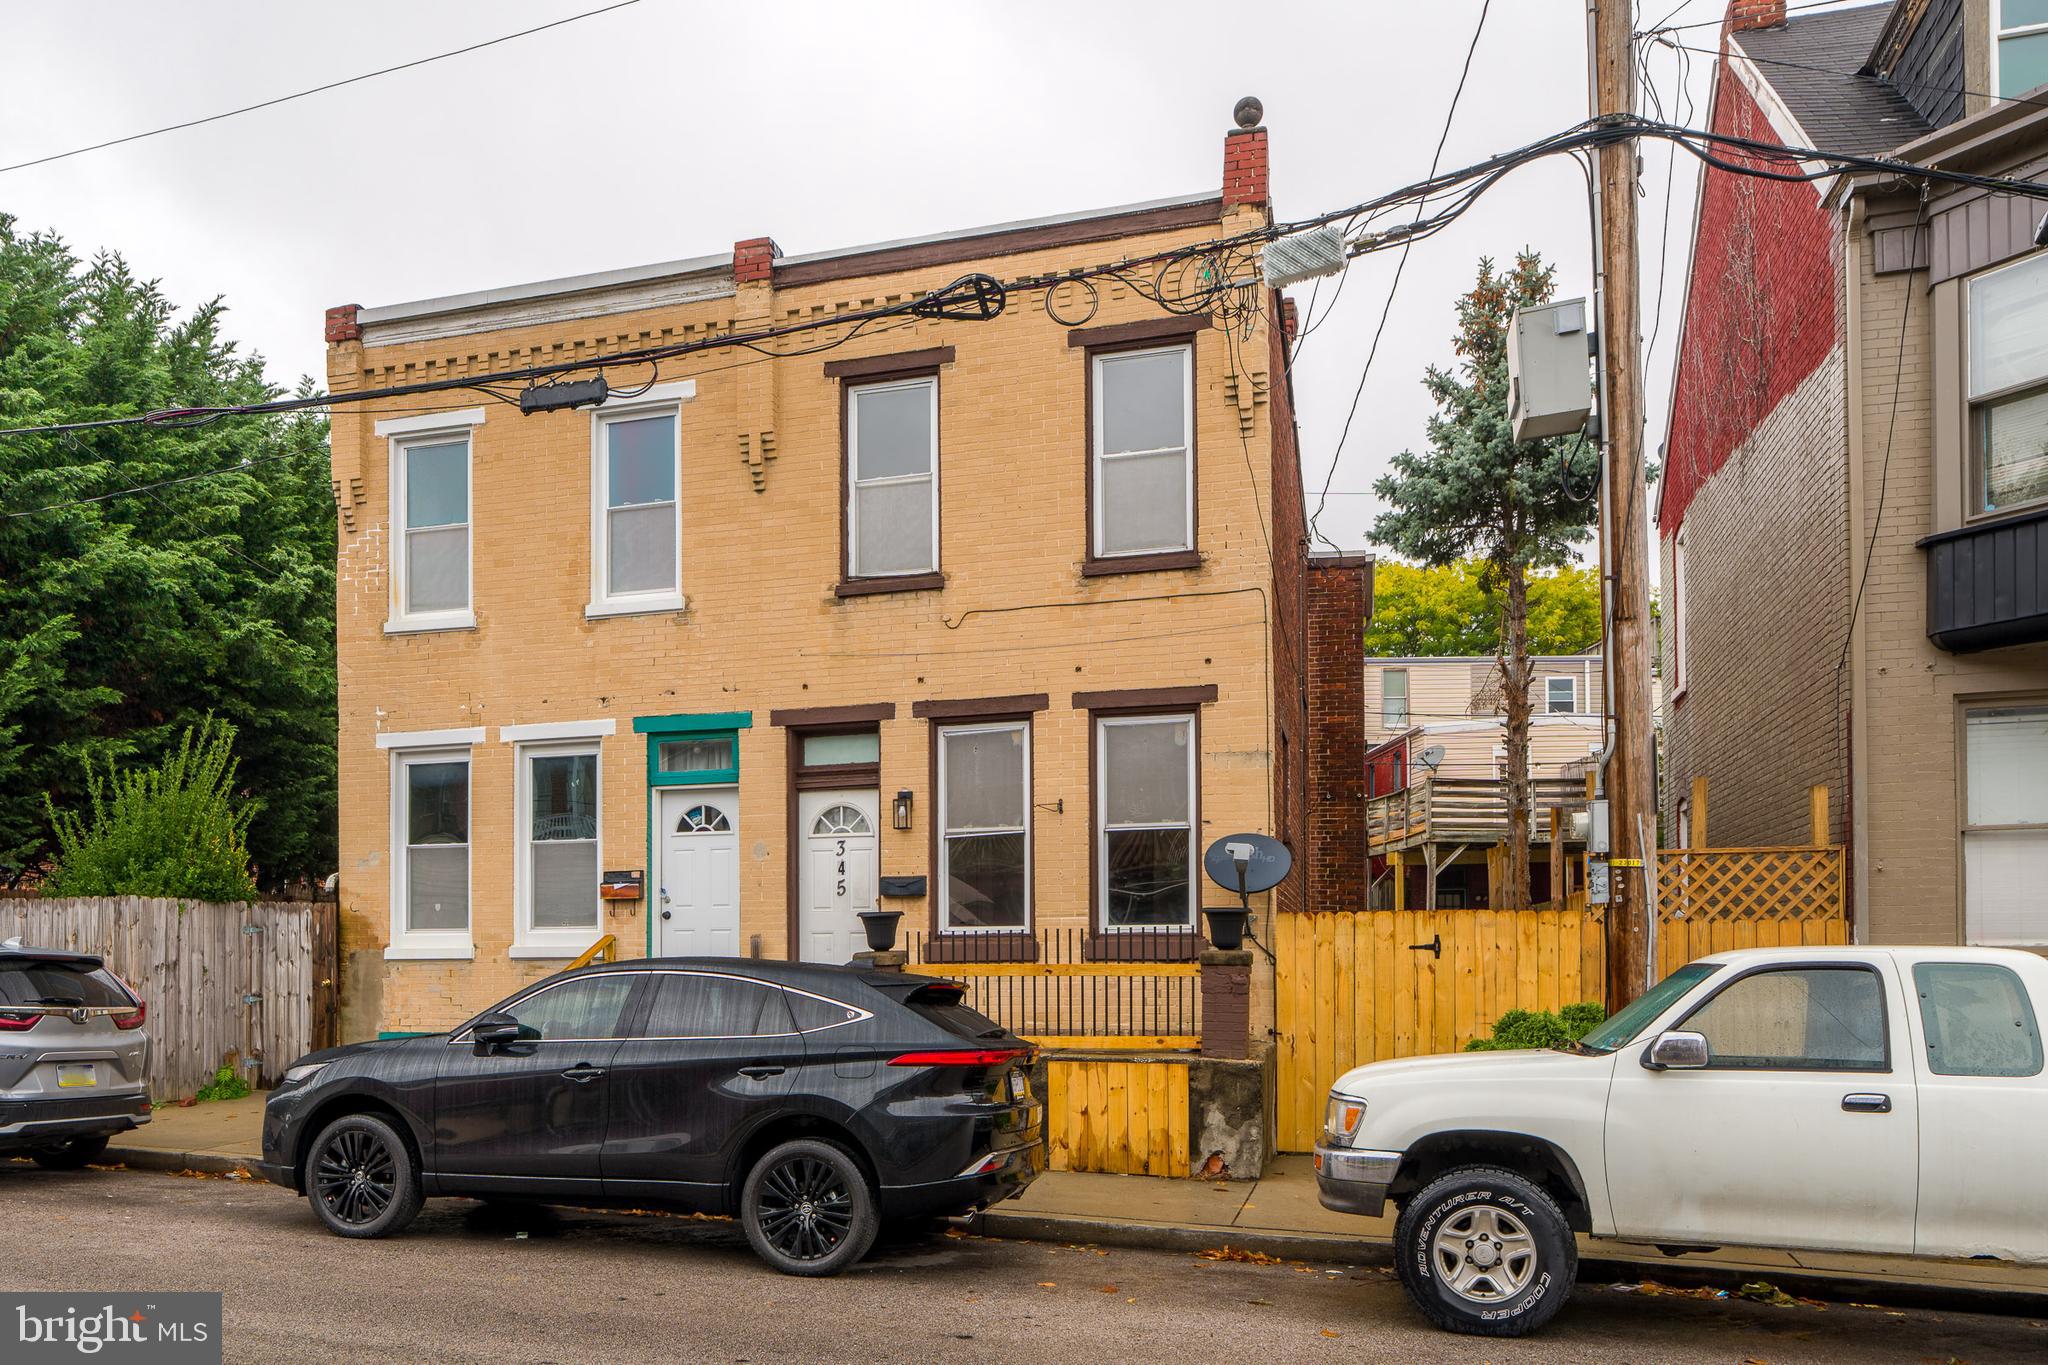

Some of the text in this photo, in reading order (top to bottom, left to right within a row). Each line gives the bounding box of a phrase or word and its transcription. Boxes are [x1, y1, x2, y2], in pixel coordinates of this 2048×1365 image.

[835, 839, 847, 897] 345
[1416, 1191, 1535, 1278] ADVENTURER A/T
[1480, 1271, 1552, 1320] COOPER
